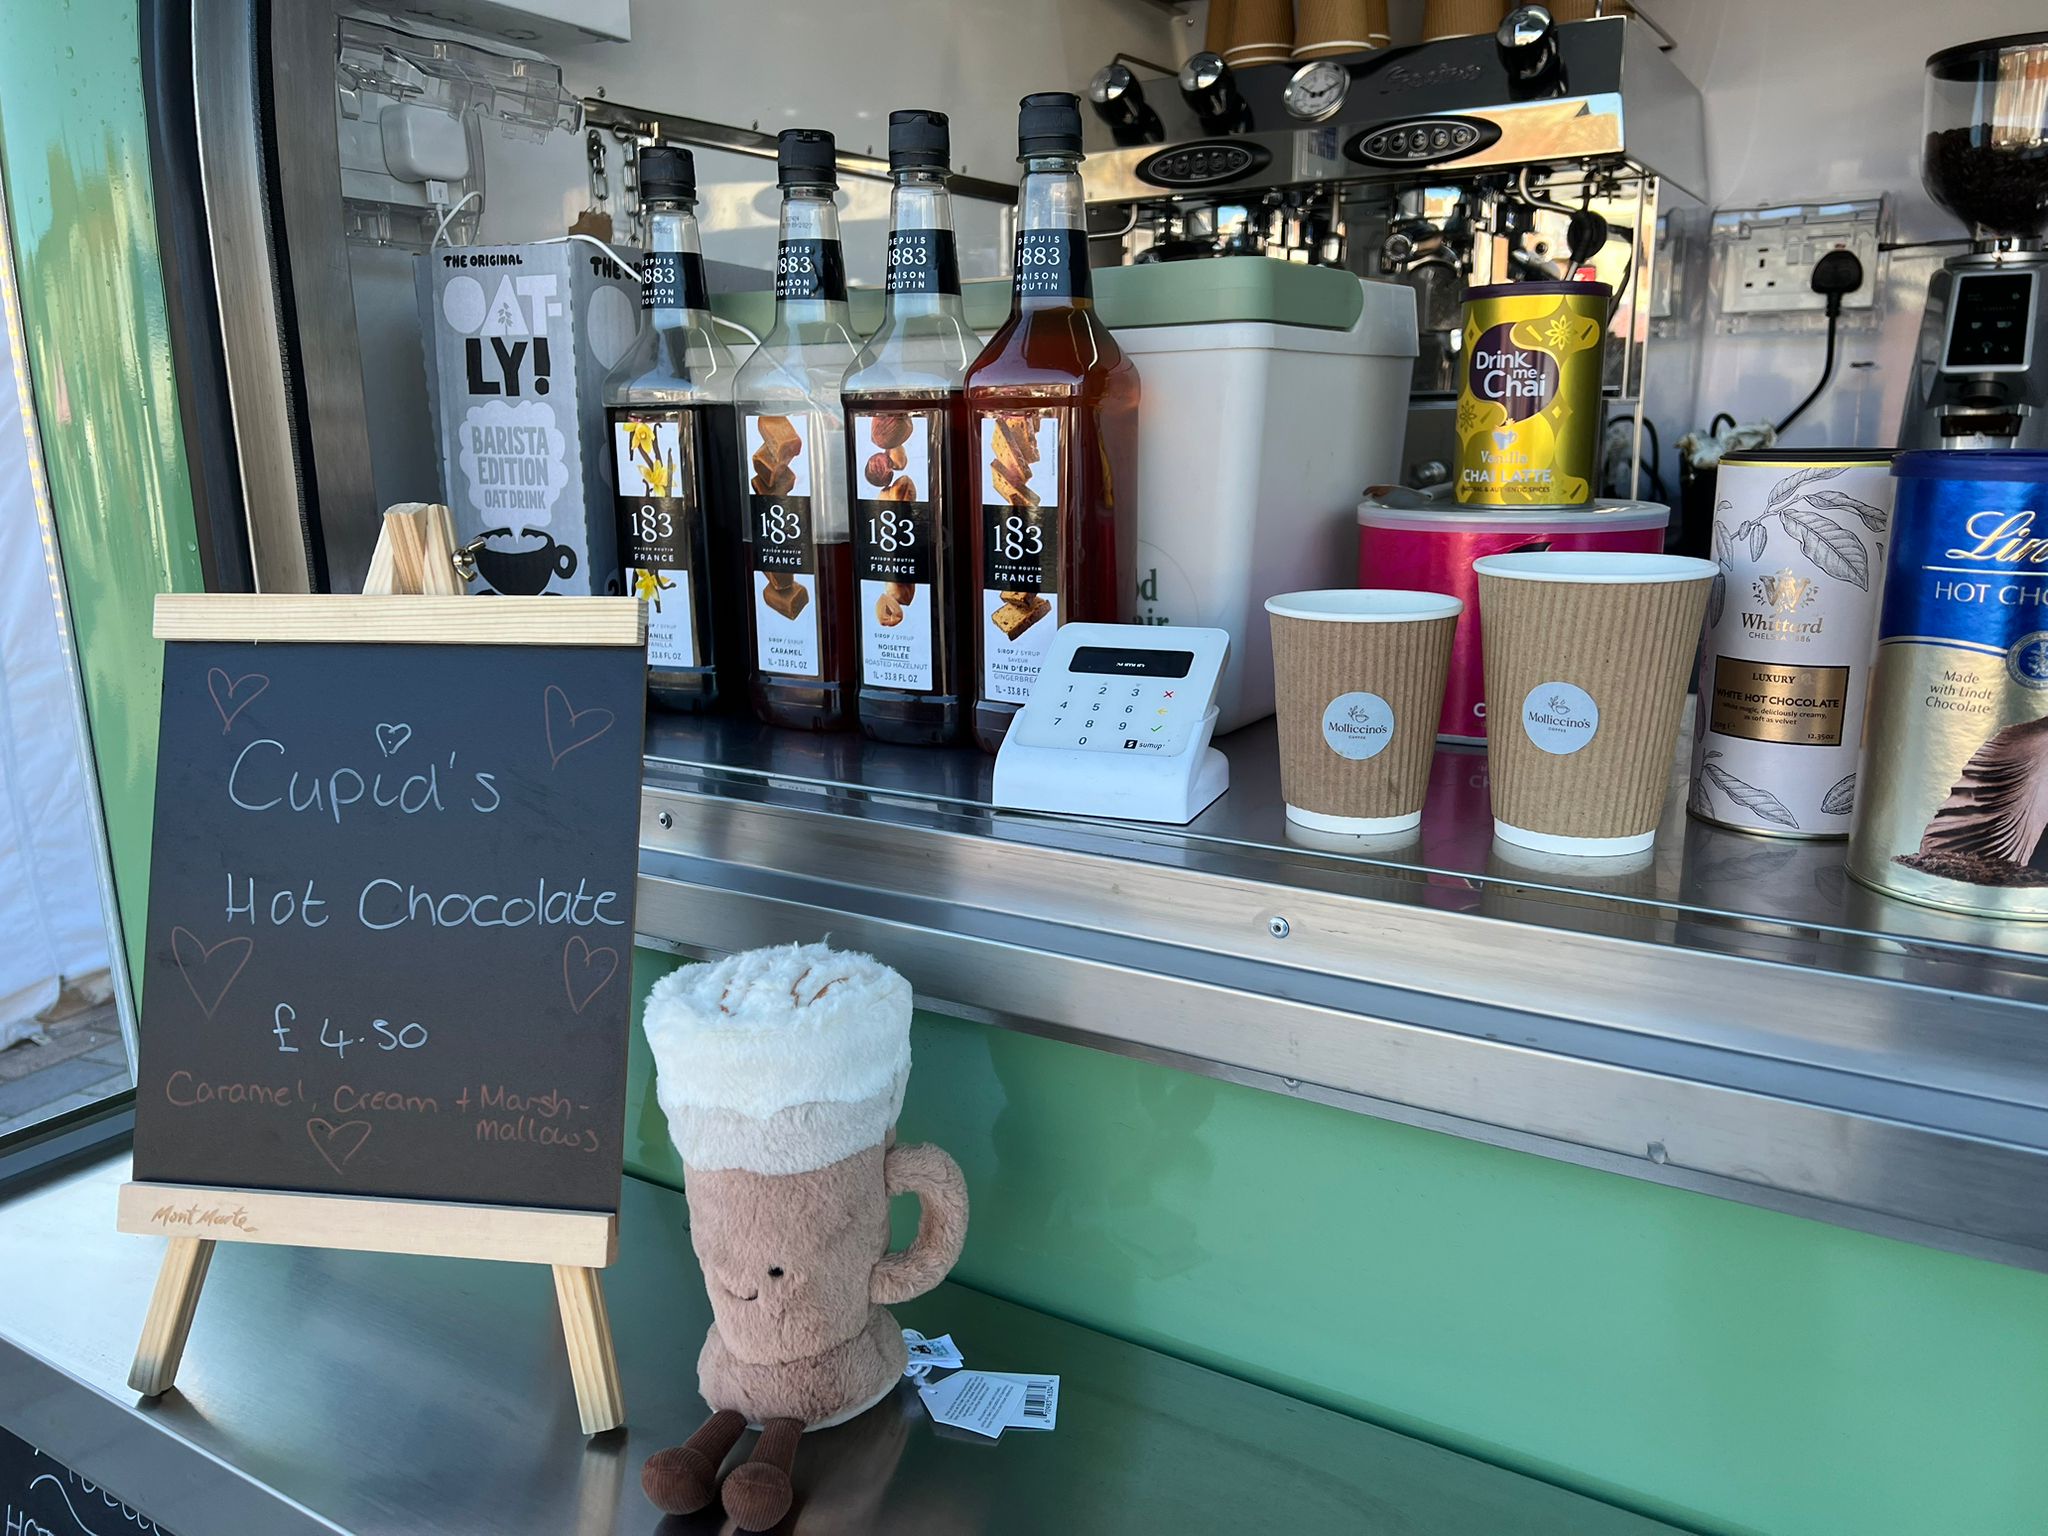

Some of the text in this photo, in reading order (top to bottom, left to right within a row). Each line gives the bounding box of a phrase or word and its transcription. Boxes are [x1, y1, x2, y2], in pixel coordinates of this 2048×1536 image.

[1017, 235, 1060, 246] DEPUIS
[443, 254, 523, 268] THE ORIGINAL
[888, 247, 927, 267] 1883
[1017, 246, 1061, 267] 1883
[1016, 271, 1058, 281] MAISON
[1015, 282, 1058, 291] ROUTIN
[465, 337, 551, 396] LY!
[1476, 350, 1532, 370] Drink
[1513, 368, 1538, 380] me
[1483, 370, 1546, 398] Chai
[472, 426, 549, 455] BARISTA
[1481, 450, 1528, 464] Vanilla
[478, 457, 549, 487] EDITION
[1463, 468, 1552, 483] CHAI LATTE
[484, 489, 546, 510] OAT DRINK
[634, 553, 674, 562] FRANCE
[762, 555, 802, 566] FRANCE
[870, 563, 916, 575] FRANCE
[994, 572, 1042, 584] FRANCE
[1935, 580, 1992, 603] HOT
[1741, 612, 1823, 634] Whittard
[649, 632, 673, 640] ANILLE
[770, 647, 803, 657] CARAMEL
[878, 643, 911, 653] NOISETTE
[991, 662, 1009, 671] PAIN
[908, 674, 918, 683] OZ
[1752, 672, 1796, 684] LUXURY
[1943, 670, 1980, 684] Made
[1098, 687, 1107, 695] 2
[1131, 688, 1140, 697] 3
[1716, 687, 1840, 709] WHITE HOT CHOCOLATE
[1930, 684, 1992, 700] with Lindt
[1059, 701, 1133, 713] 4 5 6
[1925, 696, 1991, 714] Chocolate
[1528, 711, 1591, 728] Molliccino's
[1751, 715, 1765, 723] soft
[1760, 708, 1798, 718] deliciously
[1799, 712, 1828, 720] creamy,
[1053, 718, 1127, 730] 7 8 9
[1328, 721, 1388, 734] Molliccino's
[1078, 736, 1088, 745] 0
[1139, 742, 1162, 750] sumup
[228, 738, 501, 824] Cupid's
[226, 872, 626, 931] Hot Chocolate
[166, 1070, 317, 1114] Caramel,
[334, 1085, 438, 1115] Cream
[151, 1203, 199, 1227] Mont
